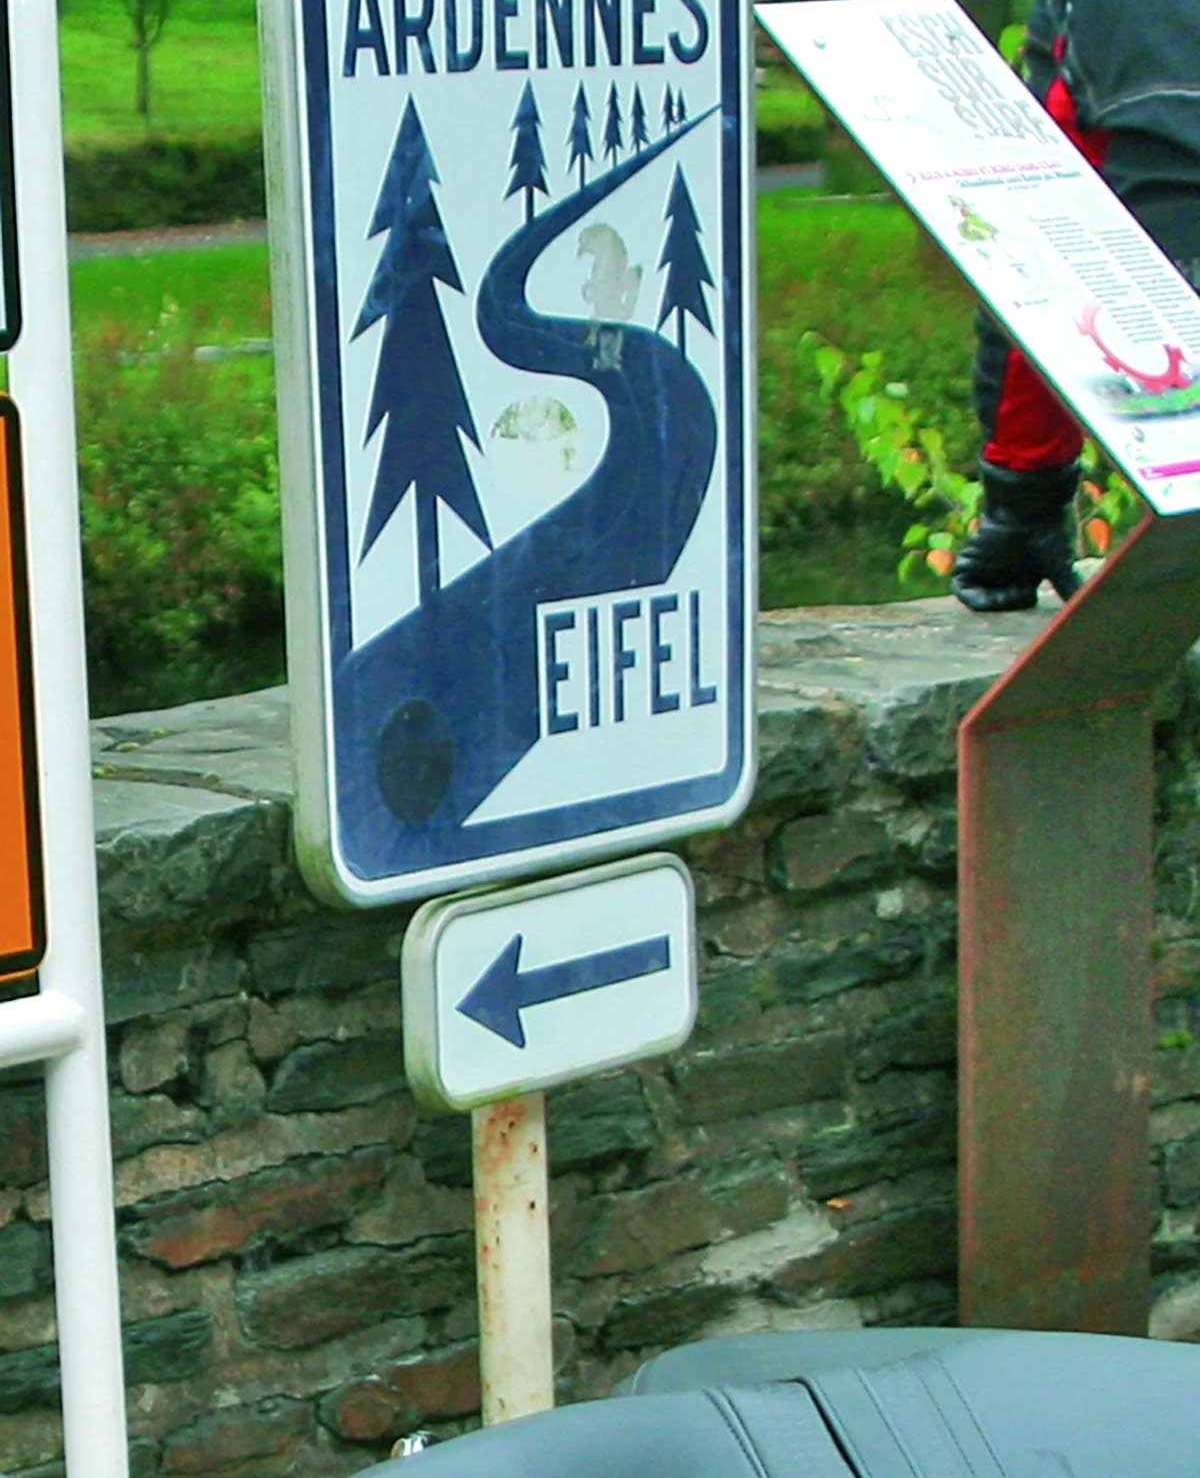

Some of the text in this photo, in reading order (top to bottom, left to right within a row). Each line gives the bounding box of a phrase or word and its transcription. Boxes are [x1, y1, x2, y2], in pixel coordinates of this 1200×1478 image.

[878, 11, 984, 59] ESCH
[917, 55, 1007, 104] SUR
[544, 590, 718, 738] EIFEL
